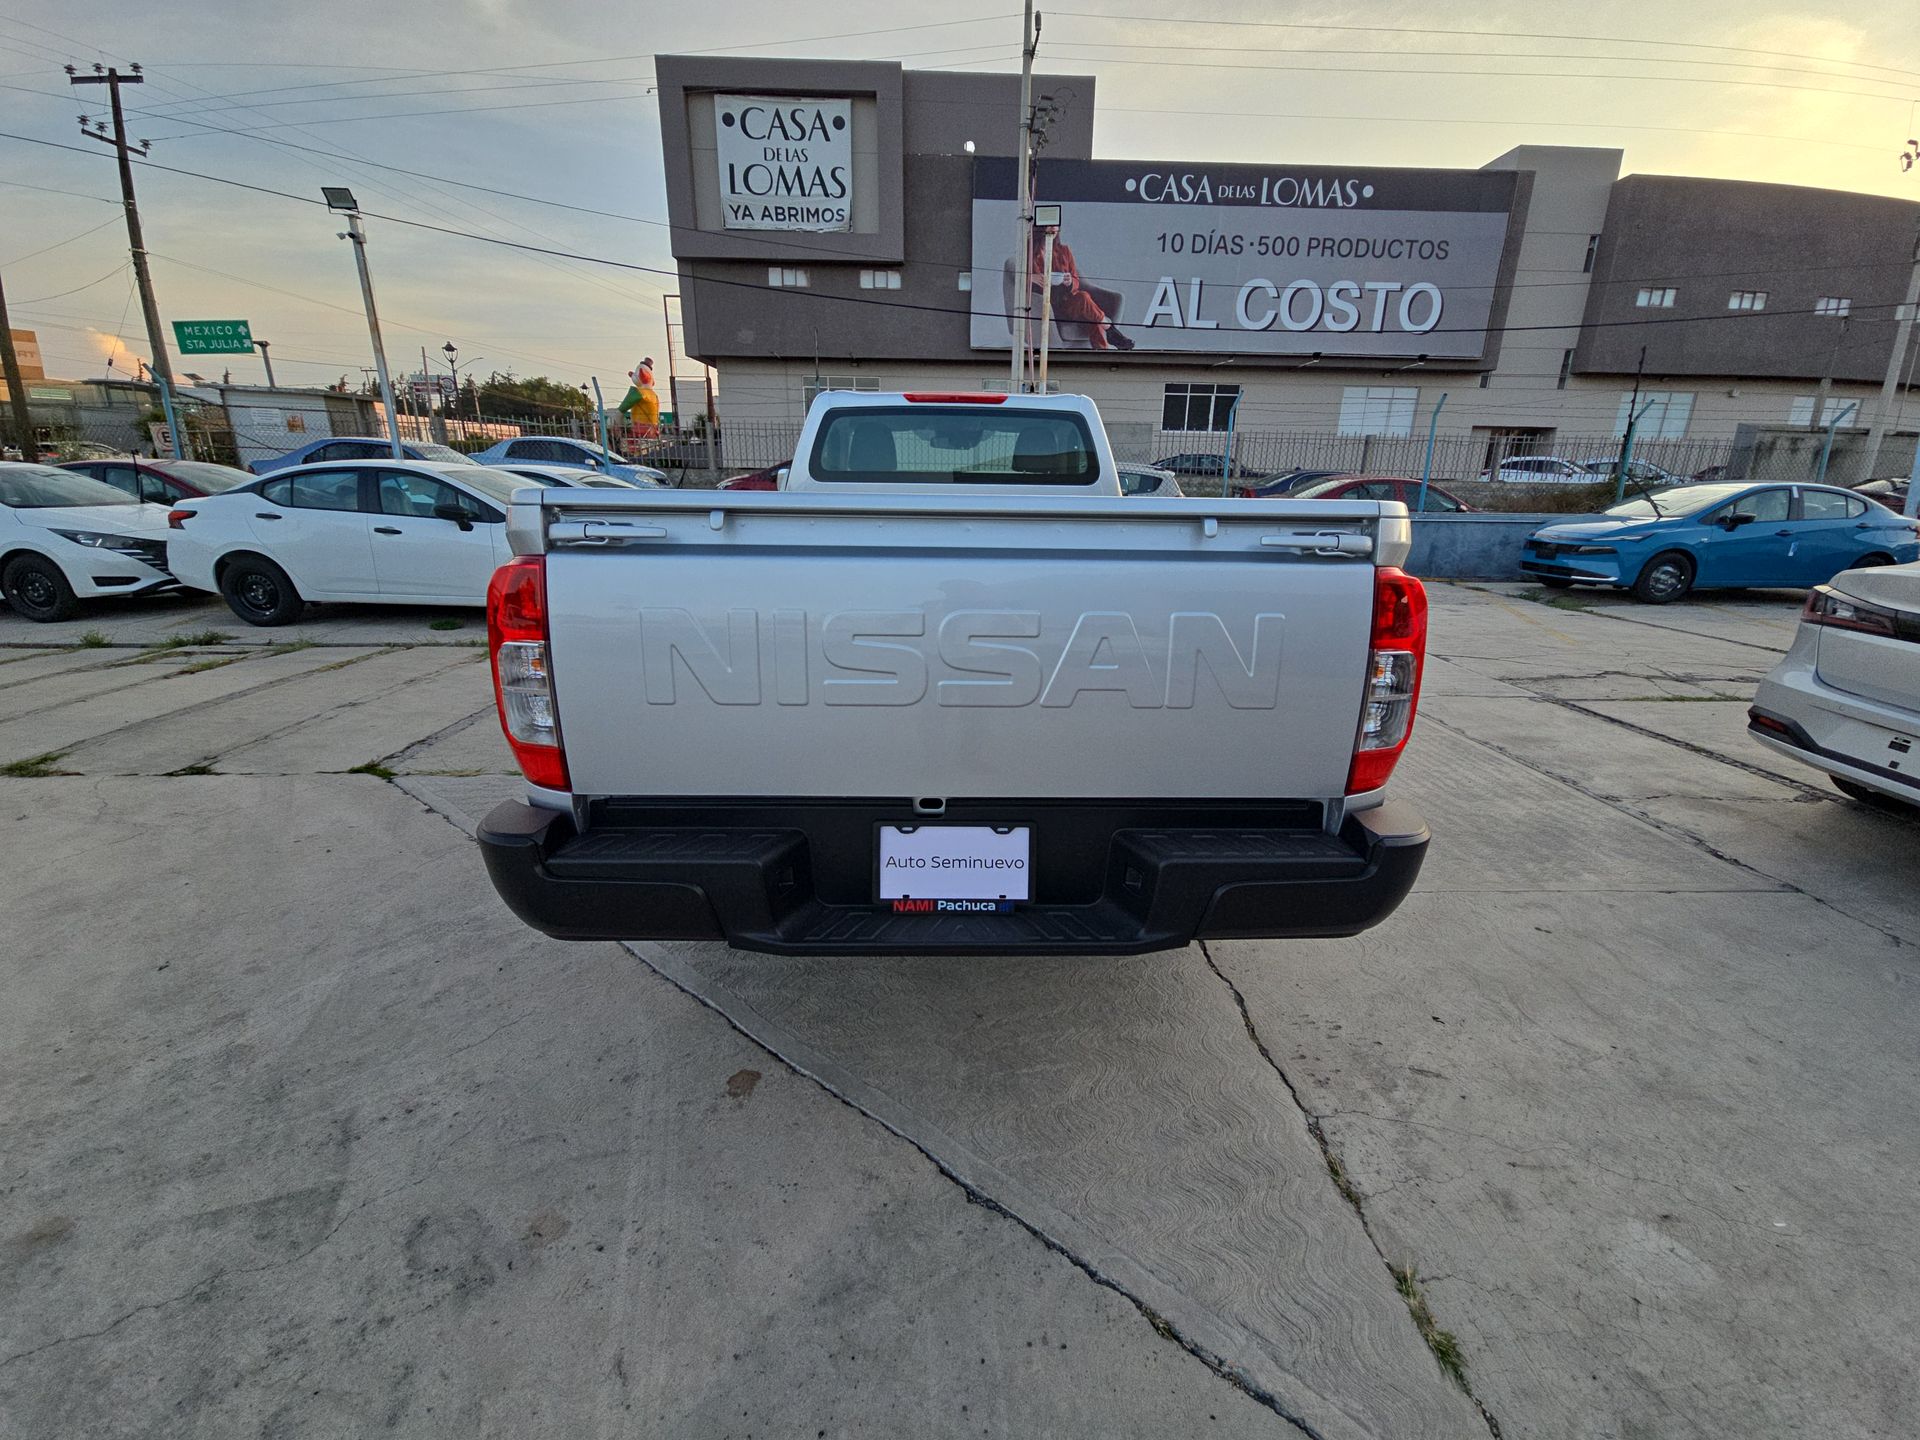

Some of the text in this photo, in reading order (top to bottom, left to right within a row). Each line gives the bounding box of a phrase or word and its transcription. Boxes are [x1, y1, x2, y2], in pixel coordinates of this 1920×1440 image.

[740, 106, 831, 142] CASA
[728, 163, 847, 199] LOMAS
[1139, 173, 1214, 203] CASA
[1260, 176, 1359, 207] LOMAS
[729, 204, 846, 223] YA ABRIMOS
[1157, 232, 1184, 253] 10
[1306, 236, 1450, 260] PRODUCTOS
[1142, 275, 1444, 335] AL COSTO
[183, 325, 233, 336] MEXICO
[185, 339, 241, 350] STA JULIA
[161, 431, 173, 444] E
[640, 607, 1286, 709] NISSAN
[885, 855, 1026, 870] Auto Seminuevo
[893, 900, 996, 912] NAMI Pachuca
